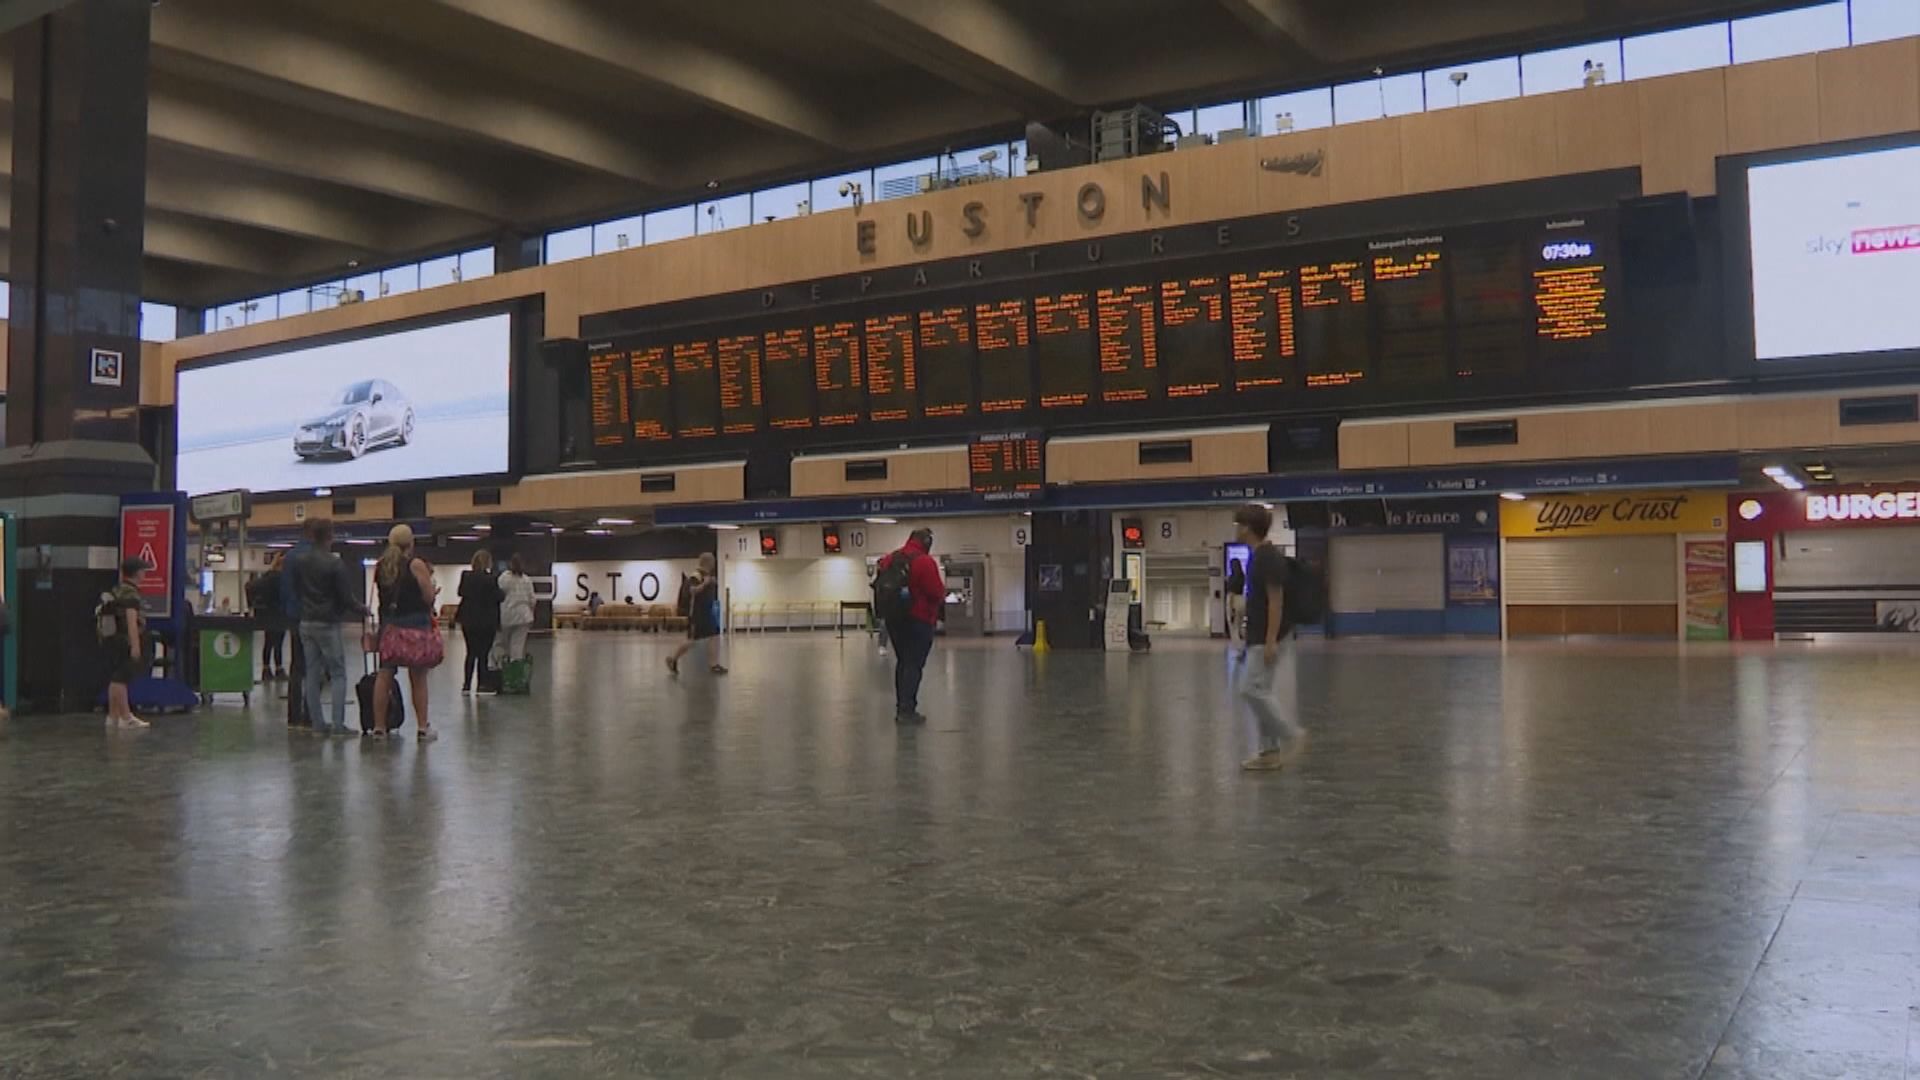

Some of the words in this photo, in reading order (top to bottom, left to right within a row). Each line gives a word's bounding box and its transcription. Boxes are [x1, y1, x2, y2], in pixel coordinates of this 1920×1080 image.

[857, 171, 1170, 255] EUSTON
[1807, 235, 1846, 255] sky
[762, 216, 1300, 308] DEPARTURES
[1436, 480, 1463, 489] Toilets
[1535, 477, 1570, 487] Changing
[1571, 475, 1594, 485] Places
[1311, 487, 1341, 497] Changing
[1342, 485, 1363, 494] Places
[1406, 510, 1460, 525] France
[1536, 499, 1611, 531] Upper
[1611, 495, 1688, 522] Crust
[1016, 528, 1026, 545] 9
[1161, 521, 1172, 539] 8
[738, 537, 748, 552] 11
[849, 531, 864, 547] 10
